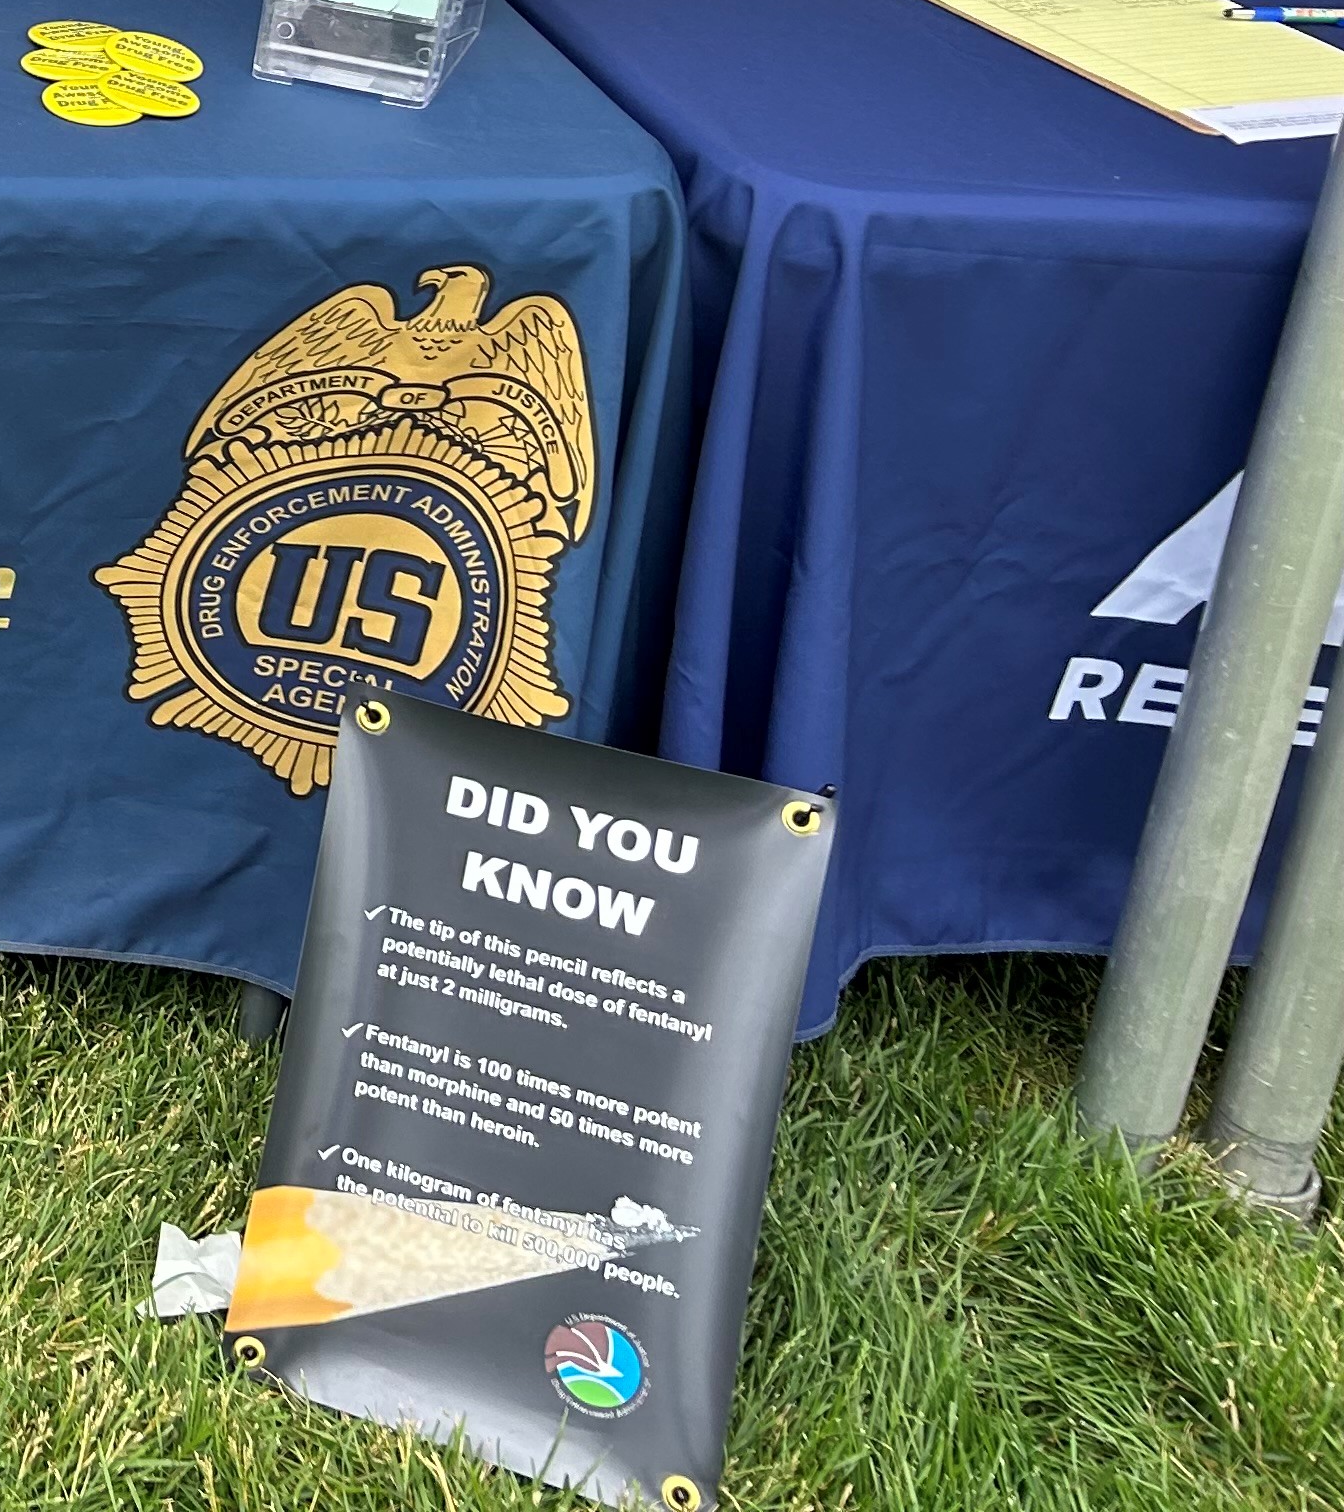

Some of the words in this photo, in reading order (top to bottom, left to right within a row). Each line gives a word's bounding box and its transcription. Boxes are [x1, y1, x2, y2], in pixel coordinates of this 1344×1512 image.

[227, 375, 374, 428] DEPARTMENT
[399, 390, 428, 405] OF
[491, 382, 559, 458] JUSTICE
[201, 573, 226, 639] DRUG
[215, 484, 413, 572] ENFORCEMENT
[411, 493, 491, 703] ADMINISTRATION
[258, 542, 446, 667] US
[445, 775, 551, 836] DID
[569, 804, 699, 874] YOU
[461, 850, 656, 937] KNOW
[377, 961, 396, 978] at
[396, 965, 439, 994] just
[442, 978, 455, 997] 2
[458, 985, 569, 1029] milligrams.
[381, 935, 486, 979] potentially
[488, 961, 544, 993] lethal
[548, 977, 598, 1008] dose
[602, 993, 625, 1016] of
[627, 1000, 714, 1042] fentanyl
[388, 906, 425, 933] The
[428, 918, 454, 942] tip
[458, 925, 481, 947] of
[483, 931, 521, 959] this
[524, 942, 588, 978] pencil
[590, 964, 669, 1000] reflects
[671, 988, 685, 1004] a
[353, 1079, 418, 1111] potent
[421, 1098, 467, 1127] than
[470, 1111, 539, 1149] heroin.
[360, 1052, 404, 1078] than
[407, 1065, 502, 1109] morphine
[505, 1095, 545, 1123] and
[549, 1104, 575, 1129] 50
[578, 1114, 636, 1147] times
[638, 1138, 695, 1166] more
[365, 1024, 451, 1065] Fentanyl
[454, 1043, 472, 1067] is
[476, 1055, 513, 1081] 100
[515, 1069, 572, 1100] times
[575, 1089, 630, 1117] more
[634, 1105, 703, 1137] potent
[335, 1173, 369, 1197] the
[371, 1184, 459, 1224] potential
[463, 1212, 484, 1234] to
[486, 1218, 519, 1247] kill
[522, 1233, 601, 1272] 500,000
[602, 1260, 682, 1299] people.
[341, 1148, 382, 1174] One
[386, 1159, 473, 1202] kilogram
[476, 1188, 500, 1209] of
[502, 1196, 584, 1236] fentanyl
[587, 1221, 626, 1250] has
